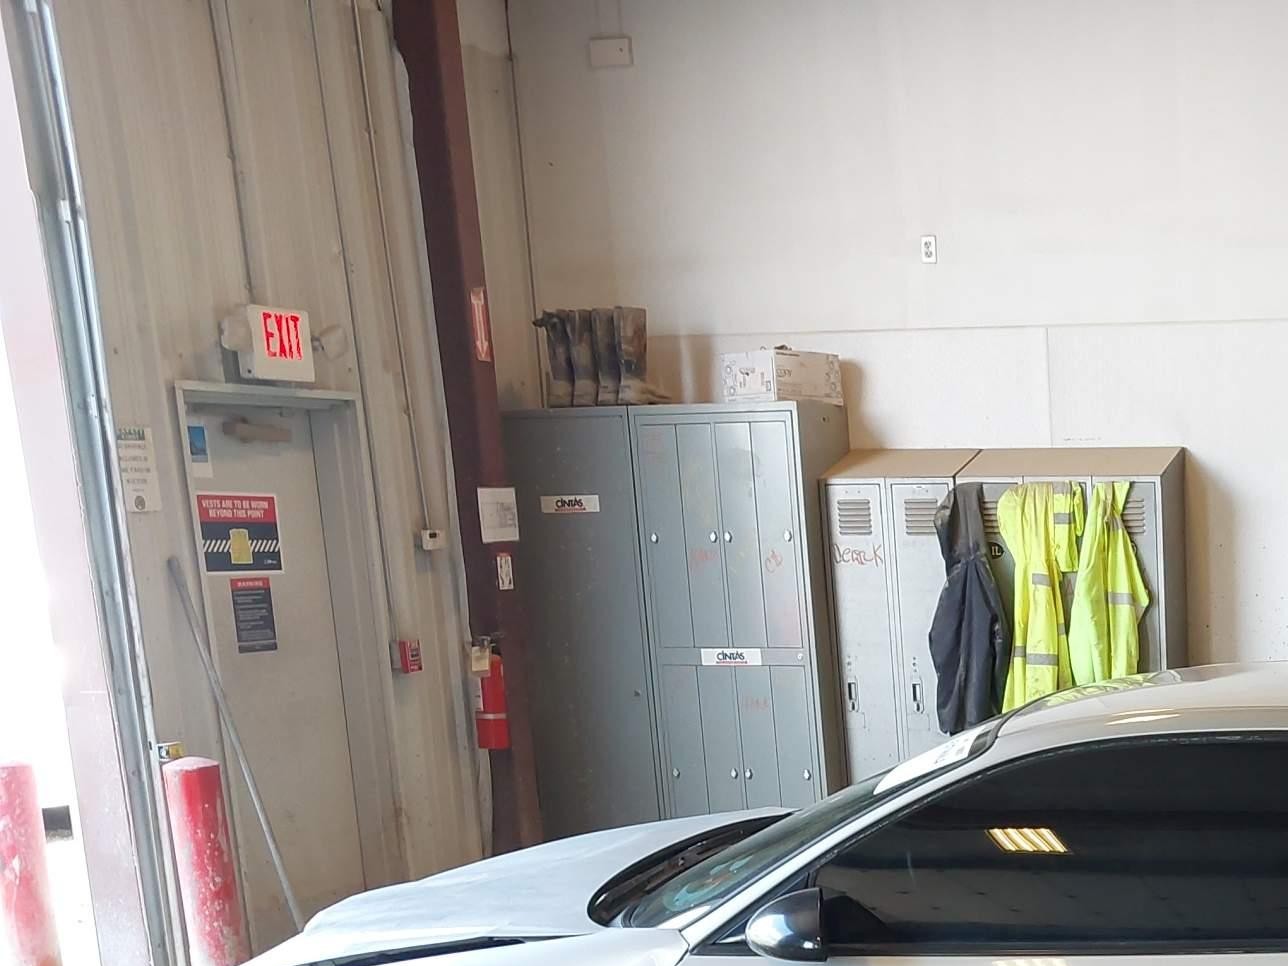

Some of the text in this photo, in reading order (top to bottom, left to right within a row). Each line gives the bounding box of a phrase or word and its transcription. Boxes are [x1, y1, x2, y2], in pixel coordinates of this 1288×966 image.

[262, 311, 302, 360] EXIT
[201, 499, 221, 508] VESTS
[233, 500, 242, 508] TO
[555, 497, 584, 508] CINTAS
[208, 508, 265, 519] BEYOND THIS POINT
[716, 650, 745, 661] CINTAS
